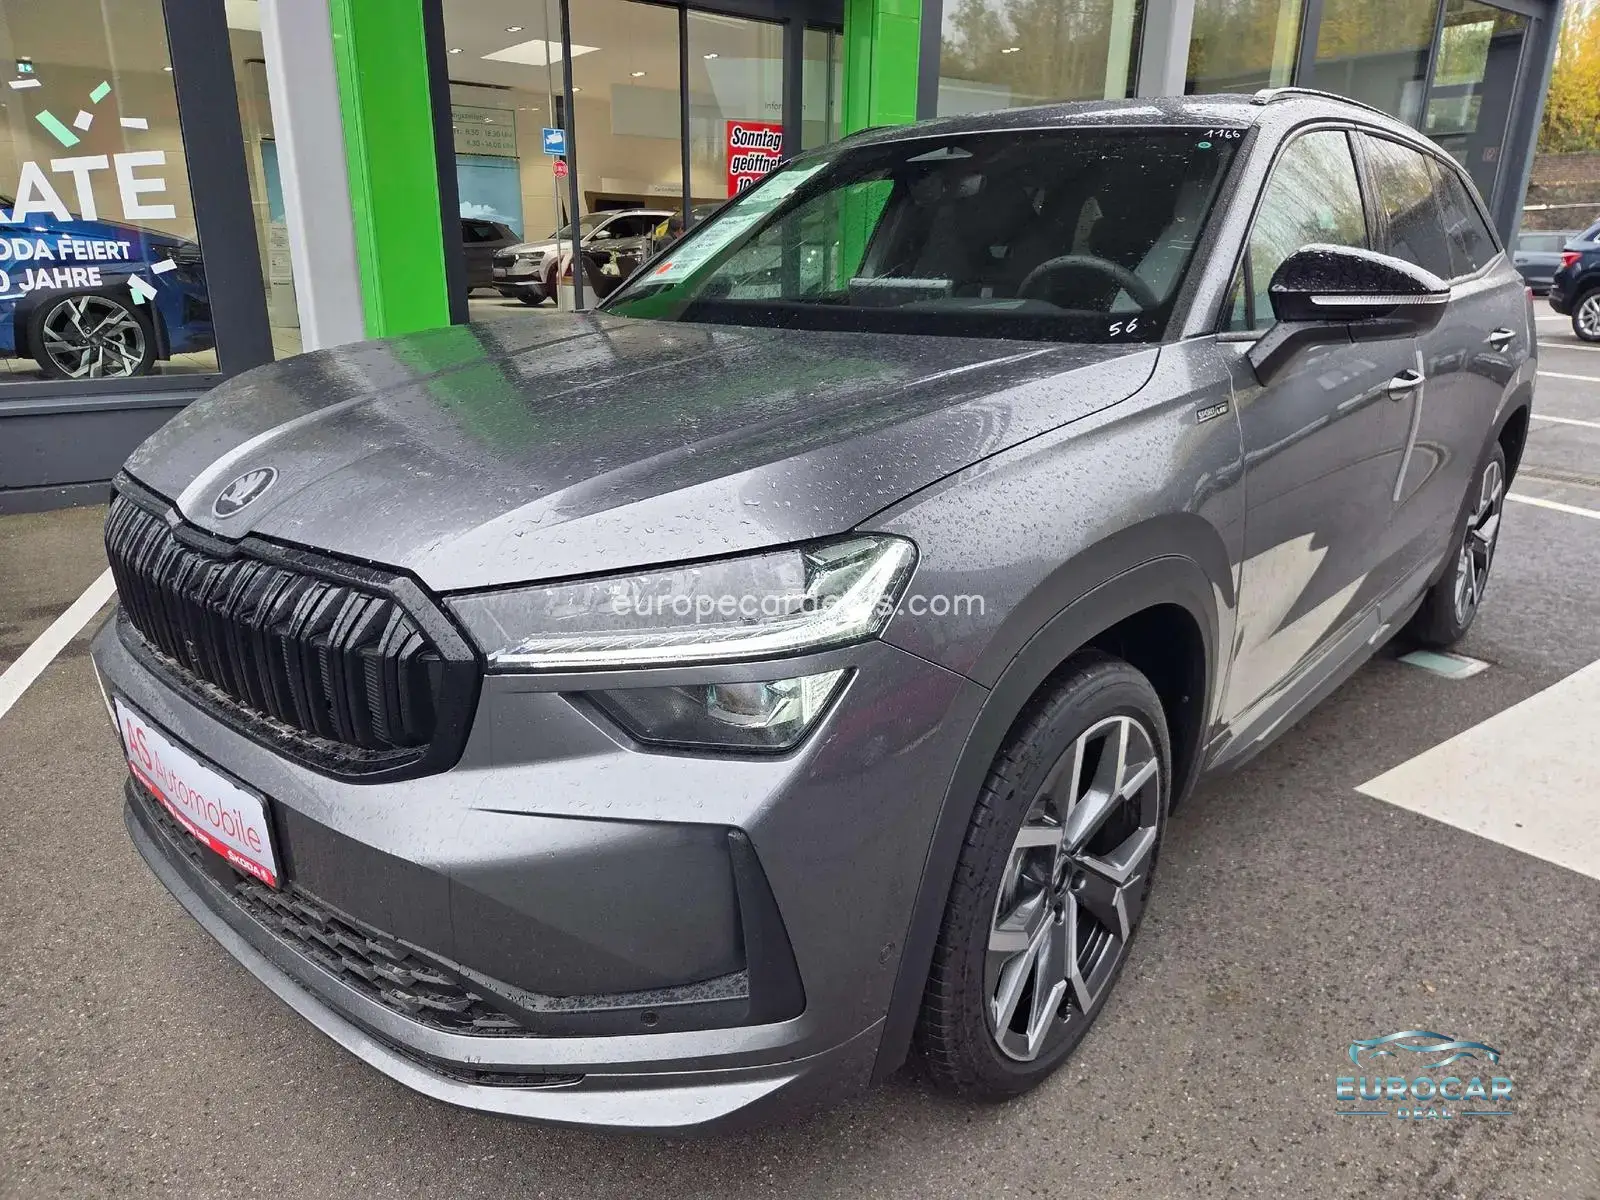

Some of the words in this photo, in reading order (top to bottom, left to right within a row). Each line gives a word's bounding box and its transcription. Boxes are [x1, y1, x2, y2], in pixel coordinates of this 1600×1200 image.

[731, 126, 782, 152] Sonntag
[1204, 129, 1241, 139] 1166
[0, 150, 177, 223] ATE
[57, 239, 131, 261] FEIERT
[19, 266, 103, 291] JAHRE
[126, 718, 152, 772] AS
[155, 751, 262, 853] Automobile
